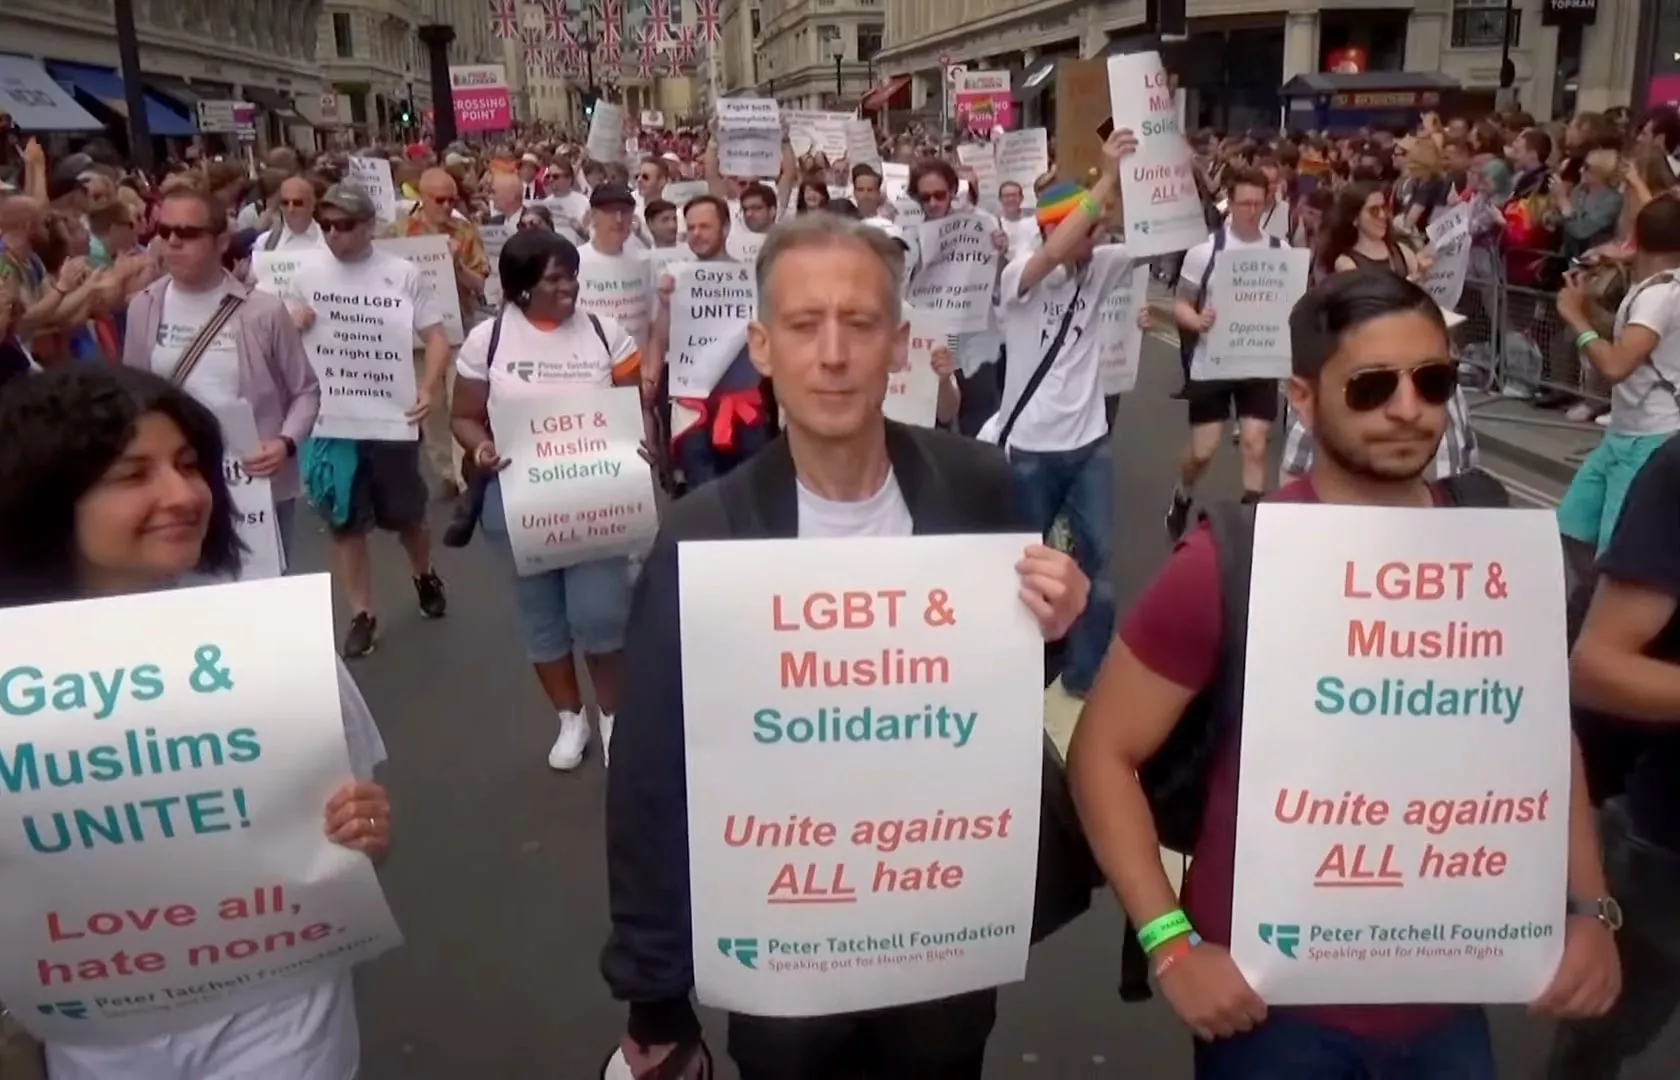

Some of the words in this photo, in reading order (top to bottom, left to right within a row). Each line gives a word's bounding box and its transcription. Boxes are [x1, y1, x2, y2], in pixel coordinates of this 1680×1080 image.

[1551, 0, 1596, 9] TOPMAN
[456, 97, 508, 111] ROSSING
[461, 109, 497, 122] POINT
[1133, 164, 1171, 182] Unite
[695, 268, 733, 285] Gays
[738, 268, 749, 281] &
[1279, 261, 1289, 274] &
[586, 279, 618, 292] Fight
[691, 286, 754, 299] Muslims
[313, 291, 360, 306] Defend
[363, 296, 403, 309] LGBT
[691, 303, 754, 320] UNITE!
[329, 310, 384, 327] Muslims
[333, 329, 384, 346] against
[912, 337, 936, 351] BT
[316, 344, 339, 357] far
[341, 346, 372, 361] right
[374, 349, 402, 361] EDL
[325, 367, 336, 378] &
[338, 366, 360, 379] far
[362, 369, 395, 383] right
[329, 386, 394, 399] Islamists
[530, 414, 586, 437] LGBT
[592, 411, 608, 429] &
[536, 437, 609, 460] Muslim
[527, 460, 623, 484] Solidarity
[521, 510, 571, 531] Unite
[576, 501, 644, 526] against
[544, 527, 583, 545] ALL
[586, 523, 629, 538] hate
[1344, 561, 1474, 600] LGBT
[1485, 562, 1508, 600] &
[773, 591, 907, 632] LGBT
[923, 588, 957, 628] &
[1347, 620, 1504, 659] Muslim
[780, 649, 950, 689] Muslim
[0, 662, 164, 720] Gays
[190, 644, 234, 693] &
[1314, 676, 1525, 724] Solidarity
[752, 704, 979, 749] Solidarity
[0, 727, 262, 793] Muslims
[23, 788, 252, 854] UNITE!
[1274, 789, 1390, 826] Unite
[1403, 789, 1550, 835] against
[723, 814, 837, 848] Unite
[850, 808, 1013, 853] against
[1313, 844, 1404, 886] ALL
[1419, 844, 1508, 879] hate
[767, 863, 858, 903] ALL
[872, 860, 965, 893] hate
[47, 899, 197, 943] Love
[218, 885, 302, 915] all,
[768, 938, 819, 955] Peter
[826, 934, 904, 953] Tatchell
[910, 922, 1017, 947] Foundation
[1310, 926, 1362, 942] Peter
[1370, 923, 1446, 941] Tatchell
[1451, 922, 1553, 941] Foundation
[37, 945, 166, 987] hate
[188, 921, 347, 966] none.
[768, 957, 827, 973] Speaking
[831, 956, 852, 968] out
[854, 955, 875, 967] for
[877, 952, 923, 966] Human
[926, 946, 966, 963] Rights
[1308, 946, 1366, 961] Speaking
[1370, 947, 1391, 957] out
[1395, 946, 1414, 957] for
[1416, 945, 1461, 956] Human
[1465, 945, 1504, 959] Rights
[95, 991, 156, 1010] Peter
[165, 973, 251, 1000] Tatchell
